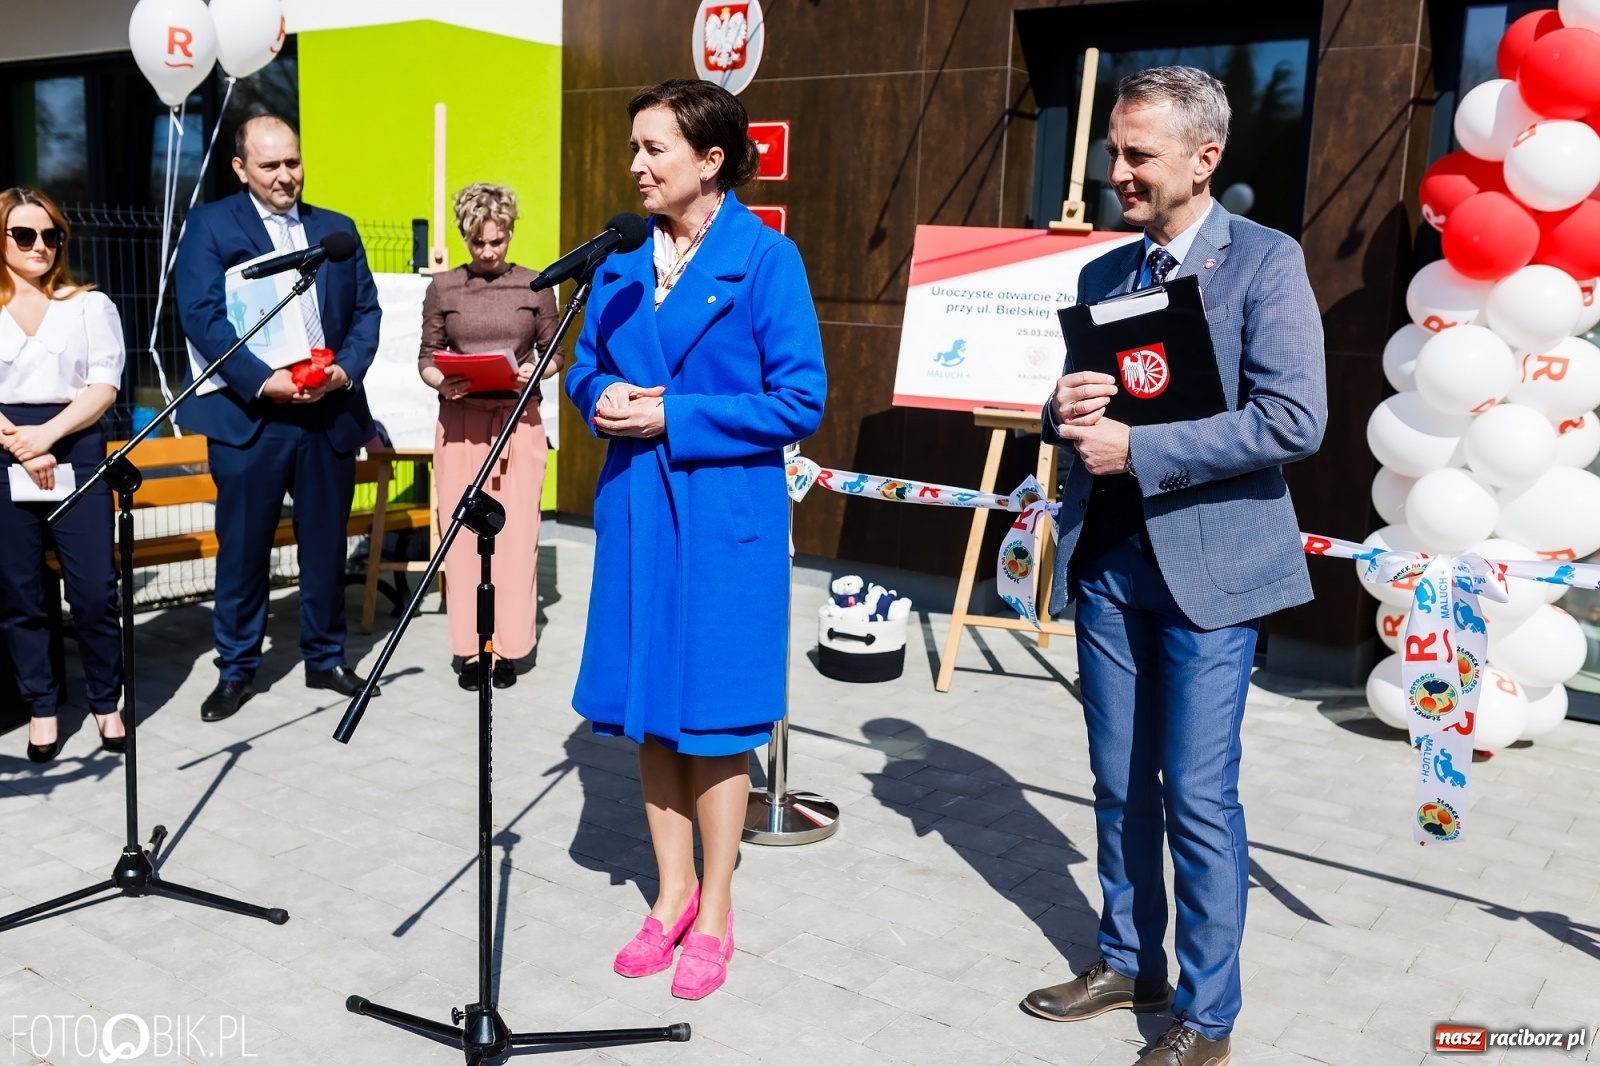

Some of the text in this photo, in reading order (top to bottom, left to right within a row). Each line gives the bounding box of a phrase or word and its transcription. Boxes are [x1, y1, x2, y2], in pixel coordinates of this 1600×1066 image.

[167, 26, 193, 58] R
[931, 286, 1076, 304] Uroczyste otwarcie Żło
[945, 303, 973, 314] przy
[976, 304, 992, 314] ul.
[996, 304, 1050, 320] Bielskiej
[1017, 328, 1064, 338] 25.03.202
[927, 369, 963, 379] MALUCH
[1531, 354, 1571, 382] R
[1438, 577, 1450, 619] MALUCH
[1383, 614, 1405, 637] R
[1405, 632, 1437, 661] R
[1421, 738, 1434, 777] MALUCH
